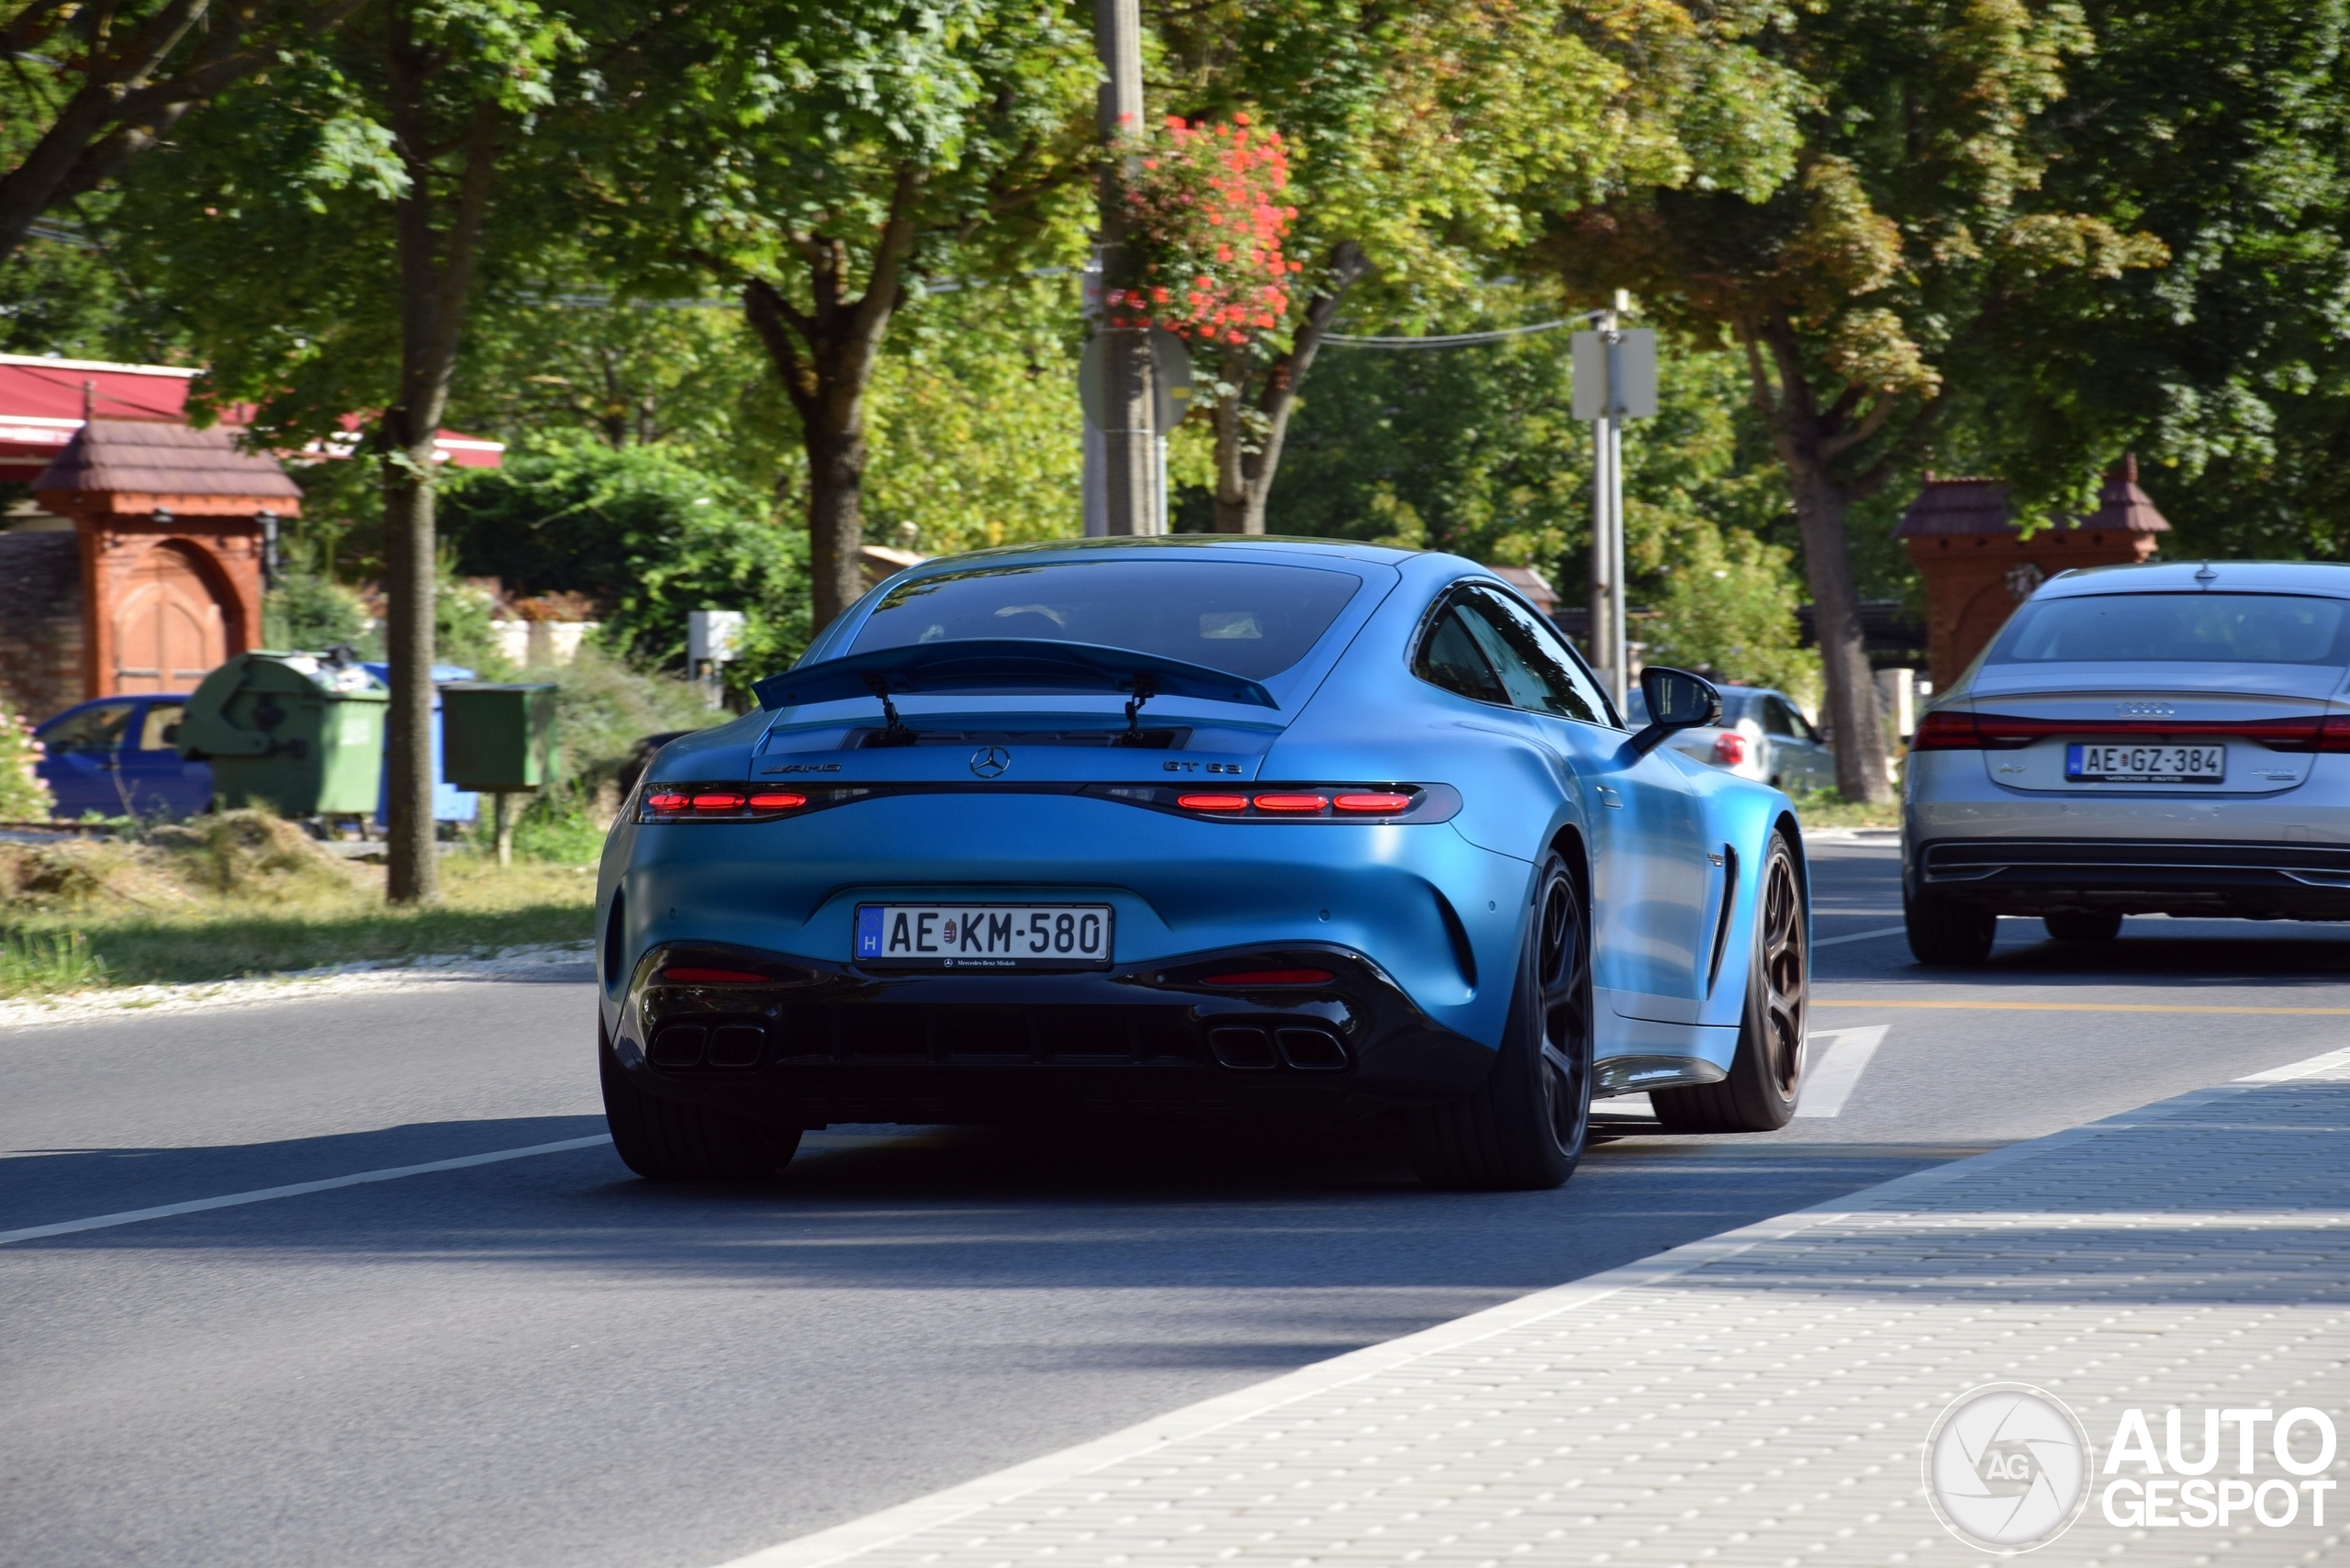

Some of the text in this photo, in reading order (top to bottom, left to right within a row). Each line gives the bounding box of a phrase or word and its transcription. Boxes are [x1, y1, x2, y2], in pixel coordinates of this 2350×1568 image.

[2087, 748, 2218, 773] AE GZ-384
[785, 764, 842, 773] AMG
[1163, 761, 1242, 775] GT 63
[889, 913, 1100, 954] AE KM-580
[864, 936, 876, 950] H
